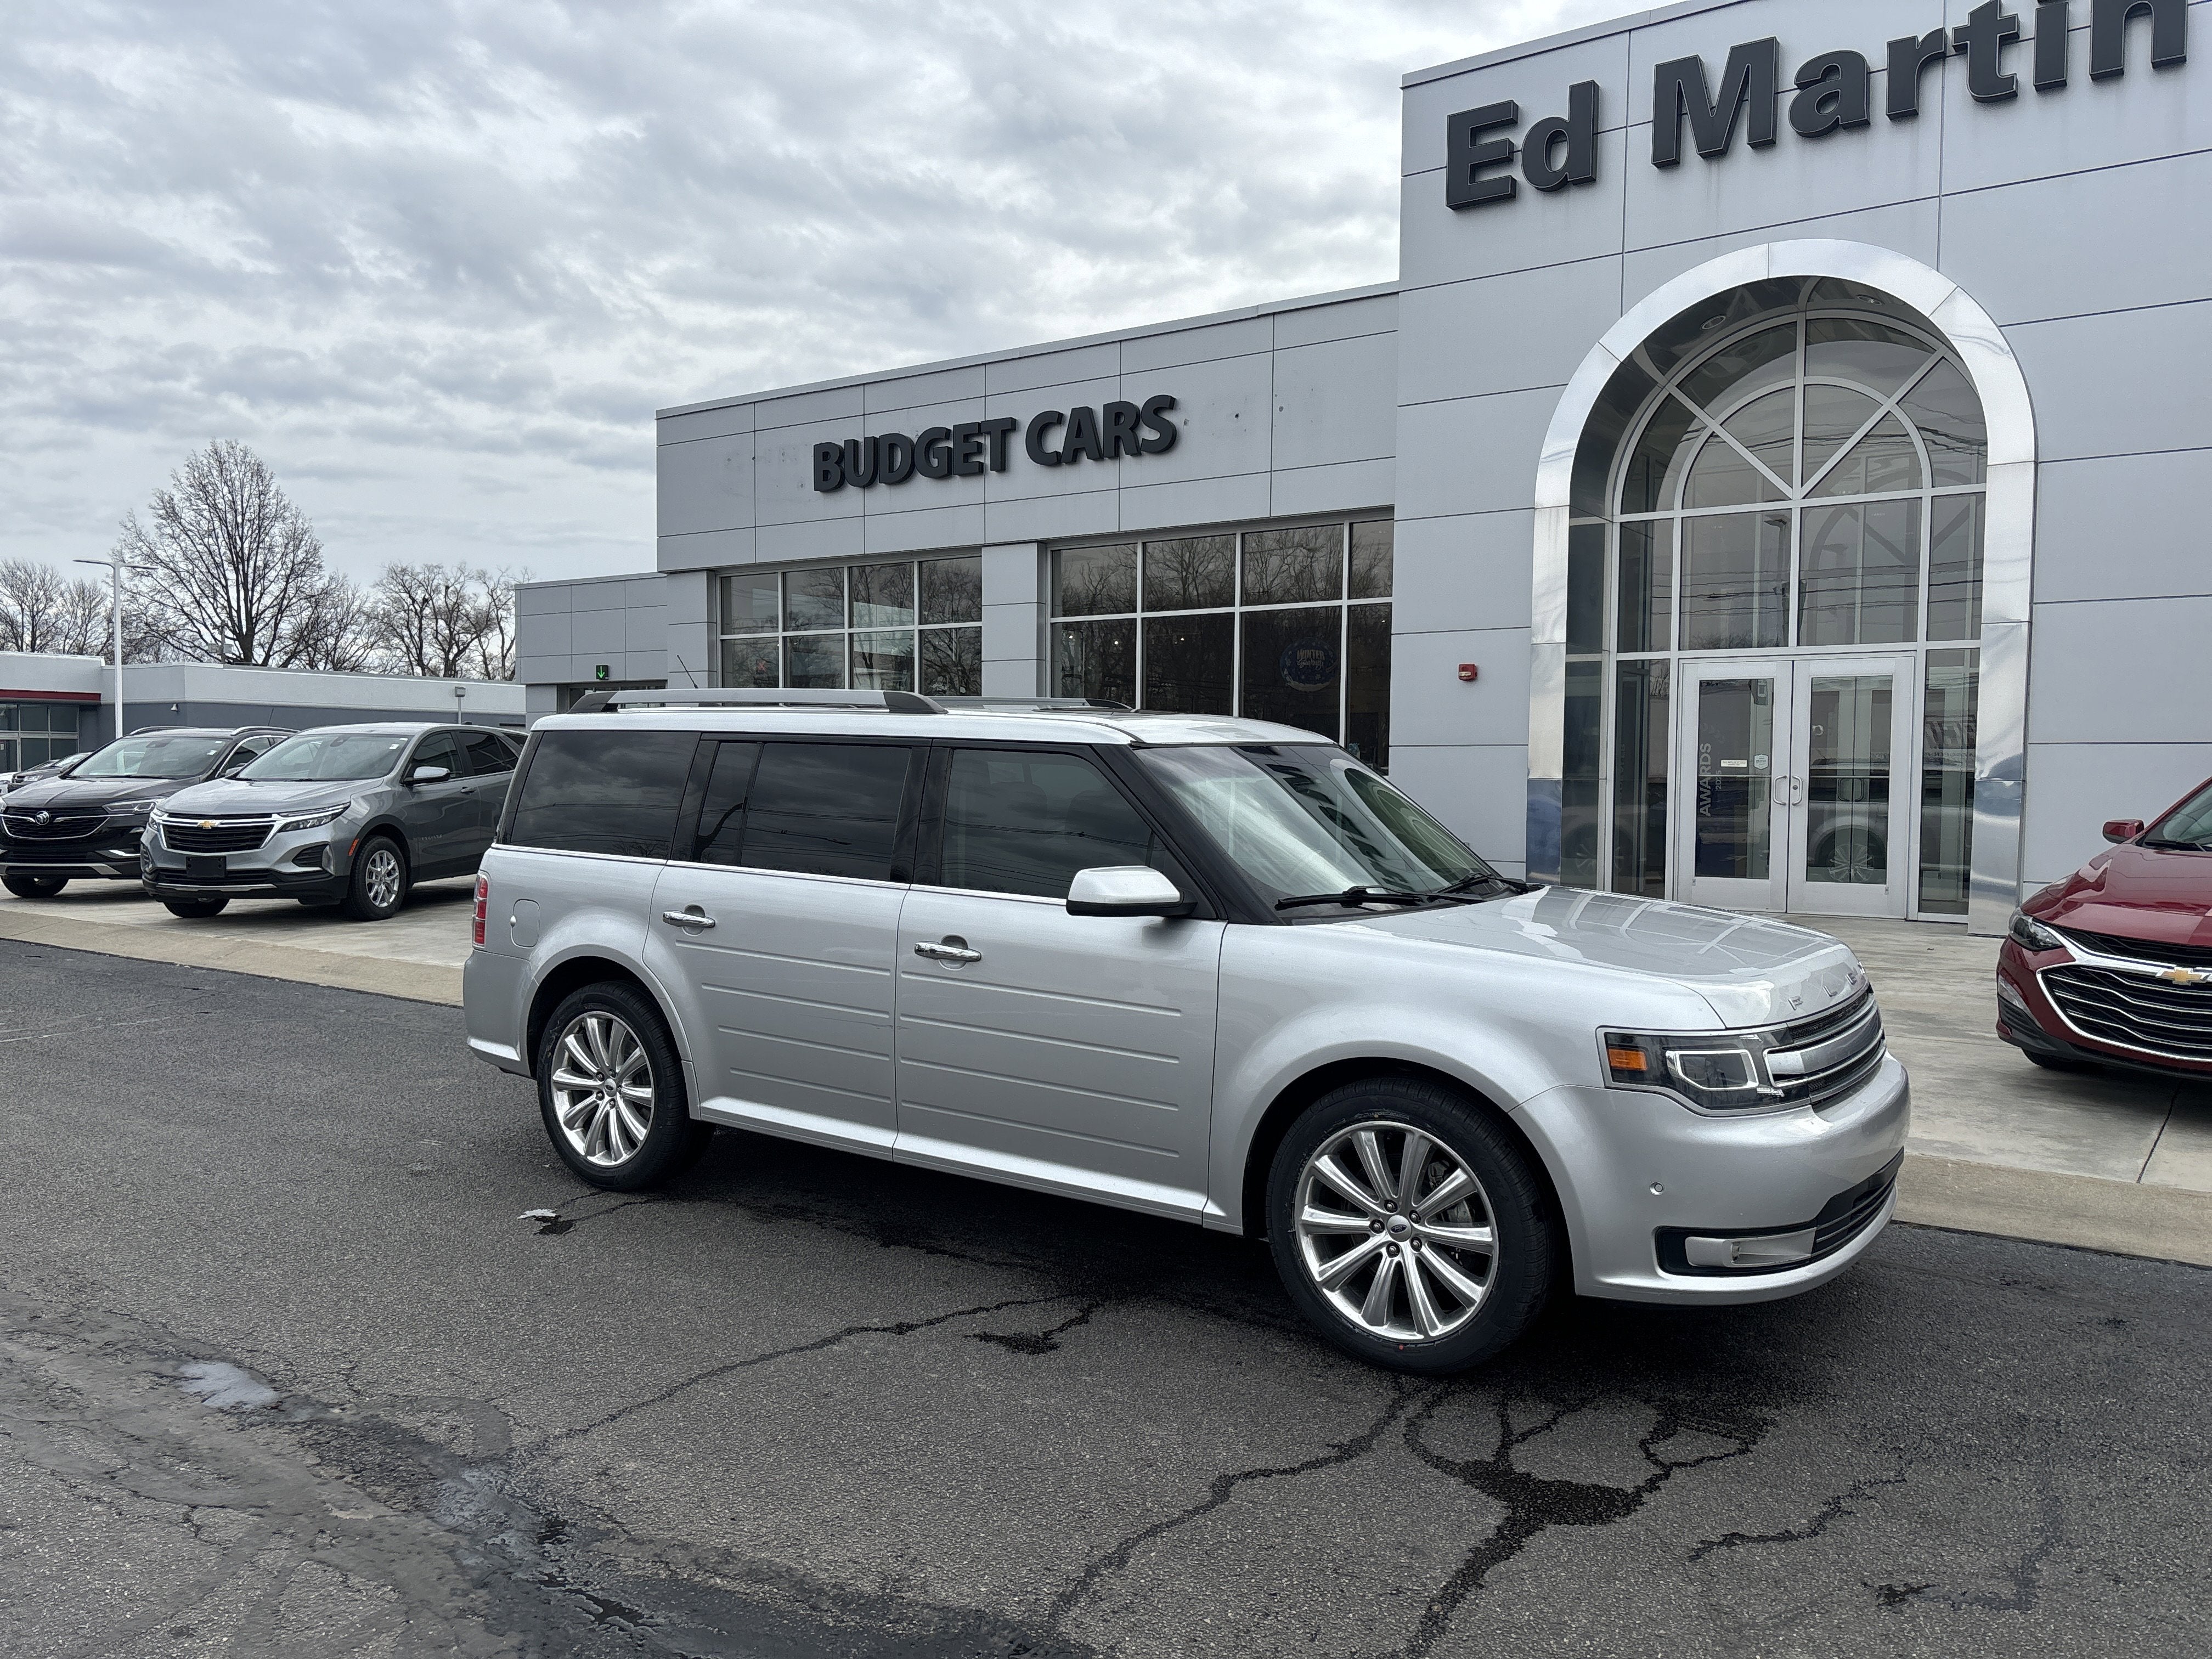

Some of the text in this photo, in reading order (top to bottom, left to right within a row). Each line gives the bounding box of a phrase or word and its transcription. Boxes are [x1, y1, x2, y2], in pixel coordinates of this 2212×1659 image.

[1445, 0, 2188, 210] Ed Martin
[813, 394, 1176, 492] BUDGET CARS
[1296, 649, 1325, 661] WINTER
[1700, 743, 1711, 816] AWARDS
